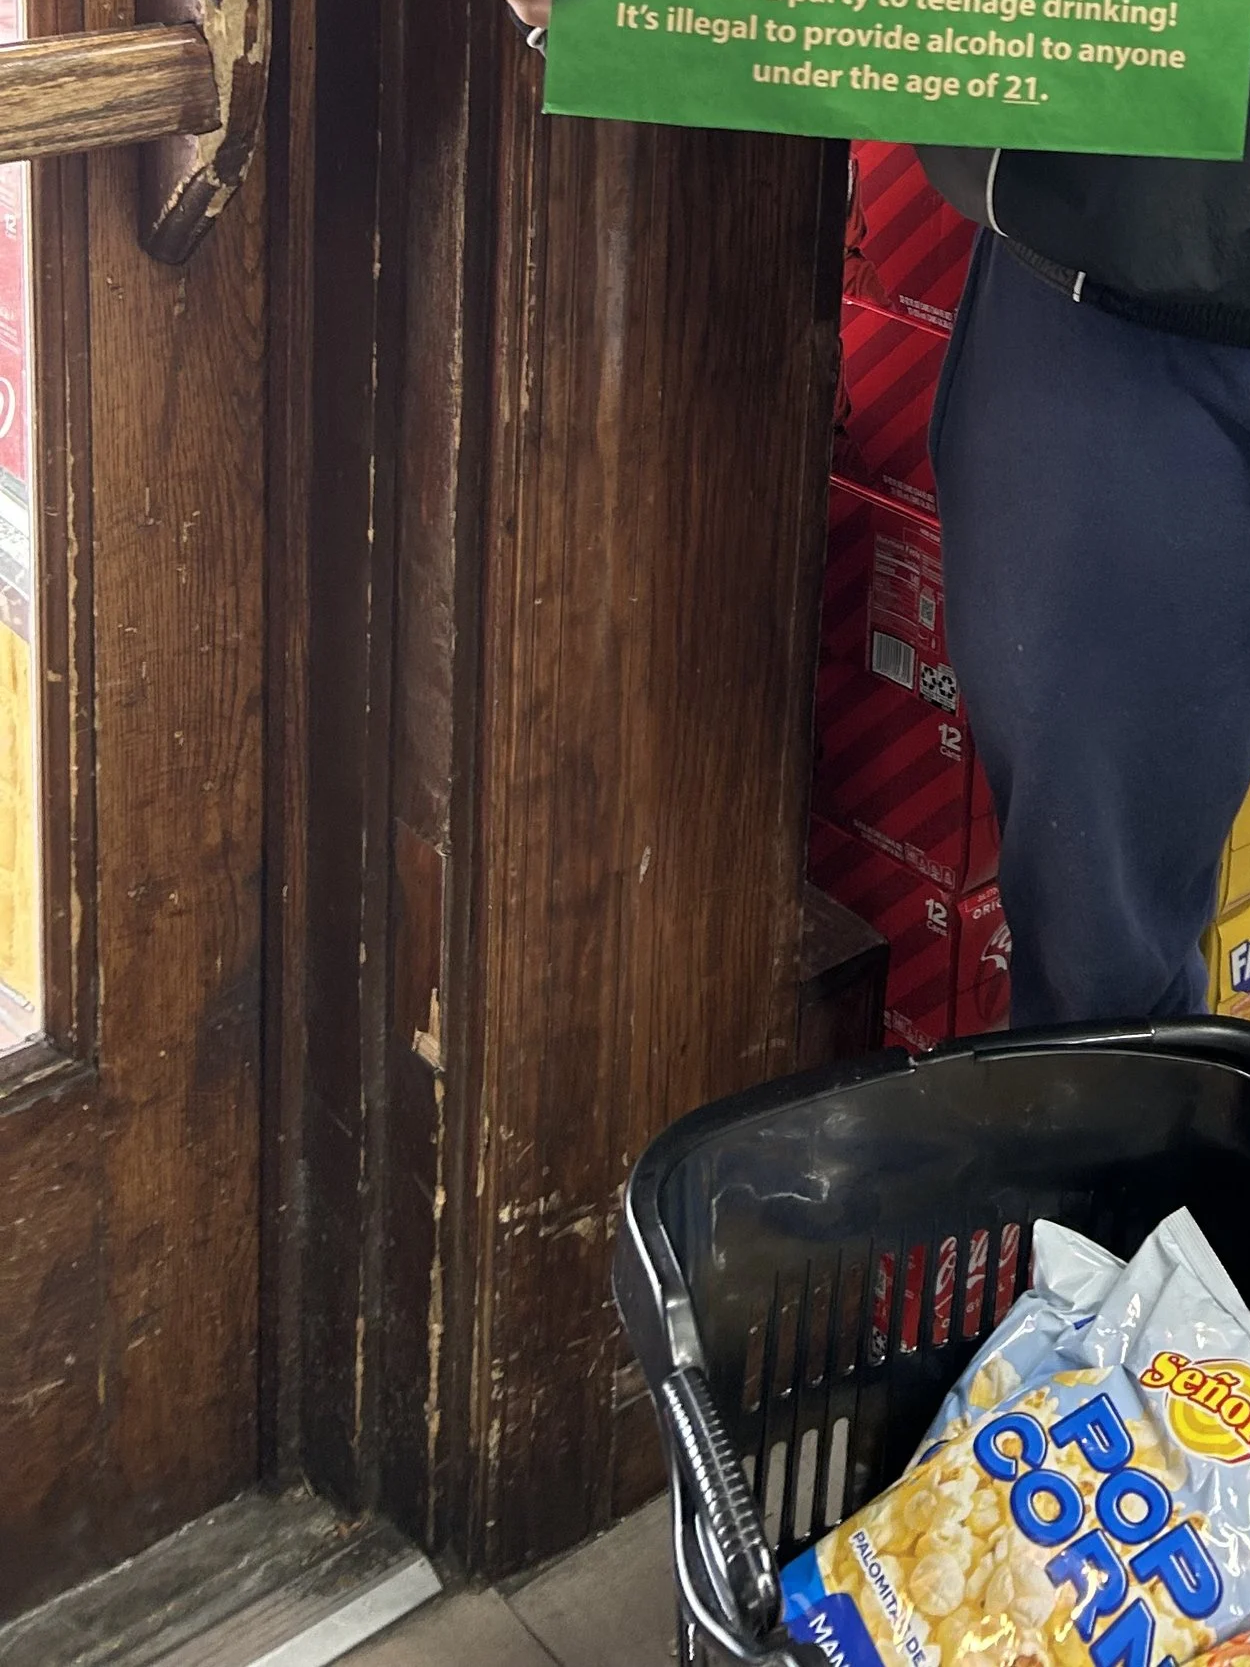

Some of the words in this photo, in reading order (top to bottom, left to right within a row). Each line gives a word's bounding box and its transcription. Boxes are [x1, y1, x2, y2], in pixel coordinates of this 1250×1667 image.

[616, 2, 660, 30] It's
[666, 6, 758, 44] illegal
[764, 19, 797, 43] to
[803, 24, 921, 51] provide
[926, 28, 1035, 59] alcohol
[1041, 36, 1073, 61] to
[1077, 43, 1187, 71] anyone
[753, 60, 844, 88] under
[850, 64, 899, 92] the
[904, 73, 960, 101] age
[966, 72, 1000, 98] of
[1003, 75, 1049, 103] 21.
[938, 724, 962, 751] 12
[925, 899, 948, 927] 12
[1050, 1391, 1225, 1620] POP
[808, 1612, 851, 1667] MAN
